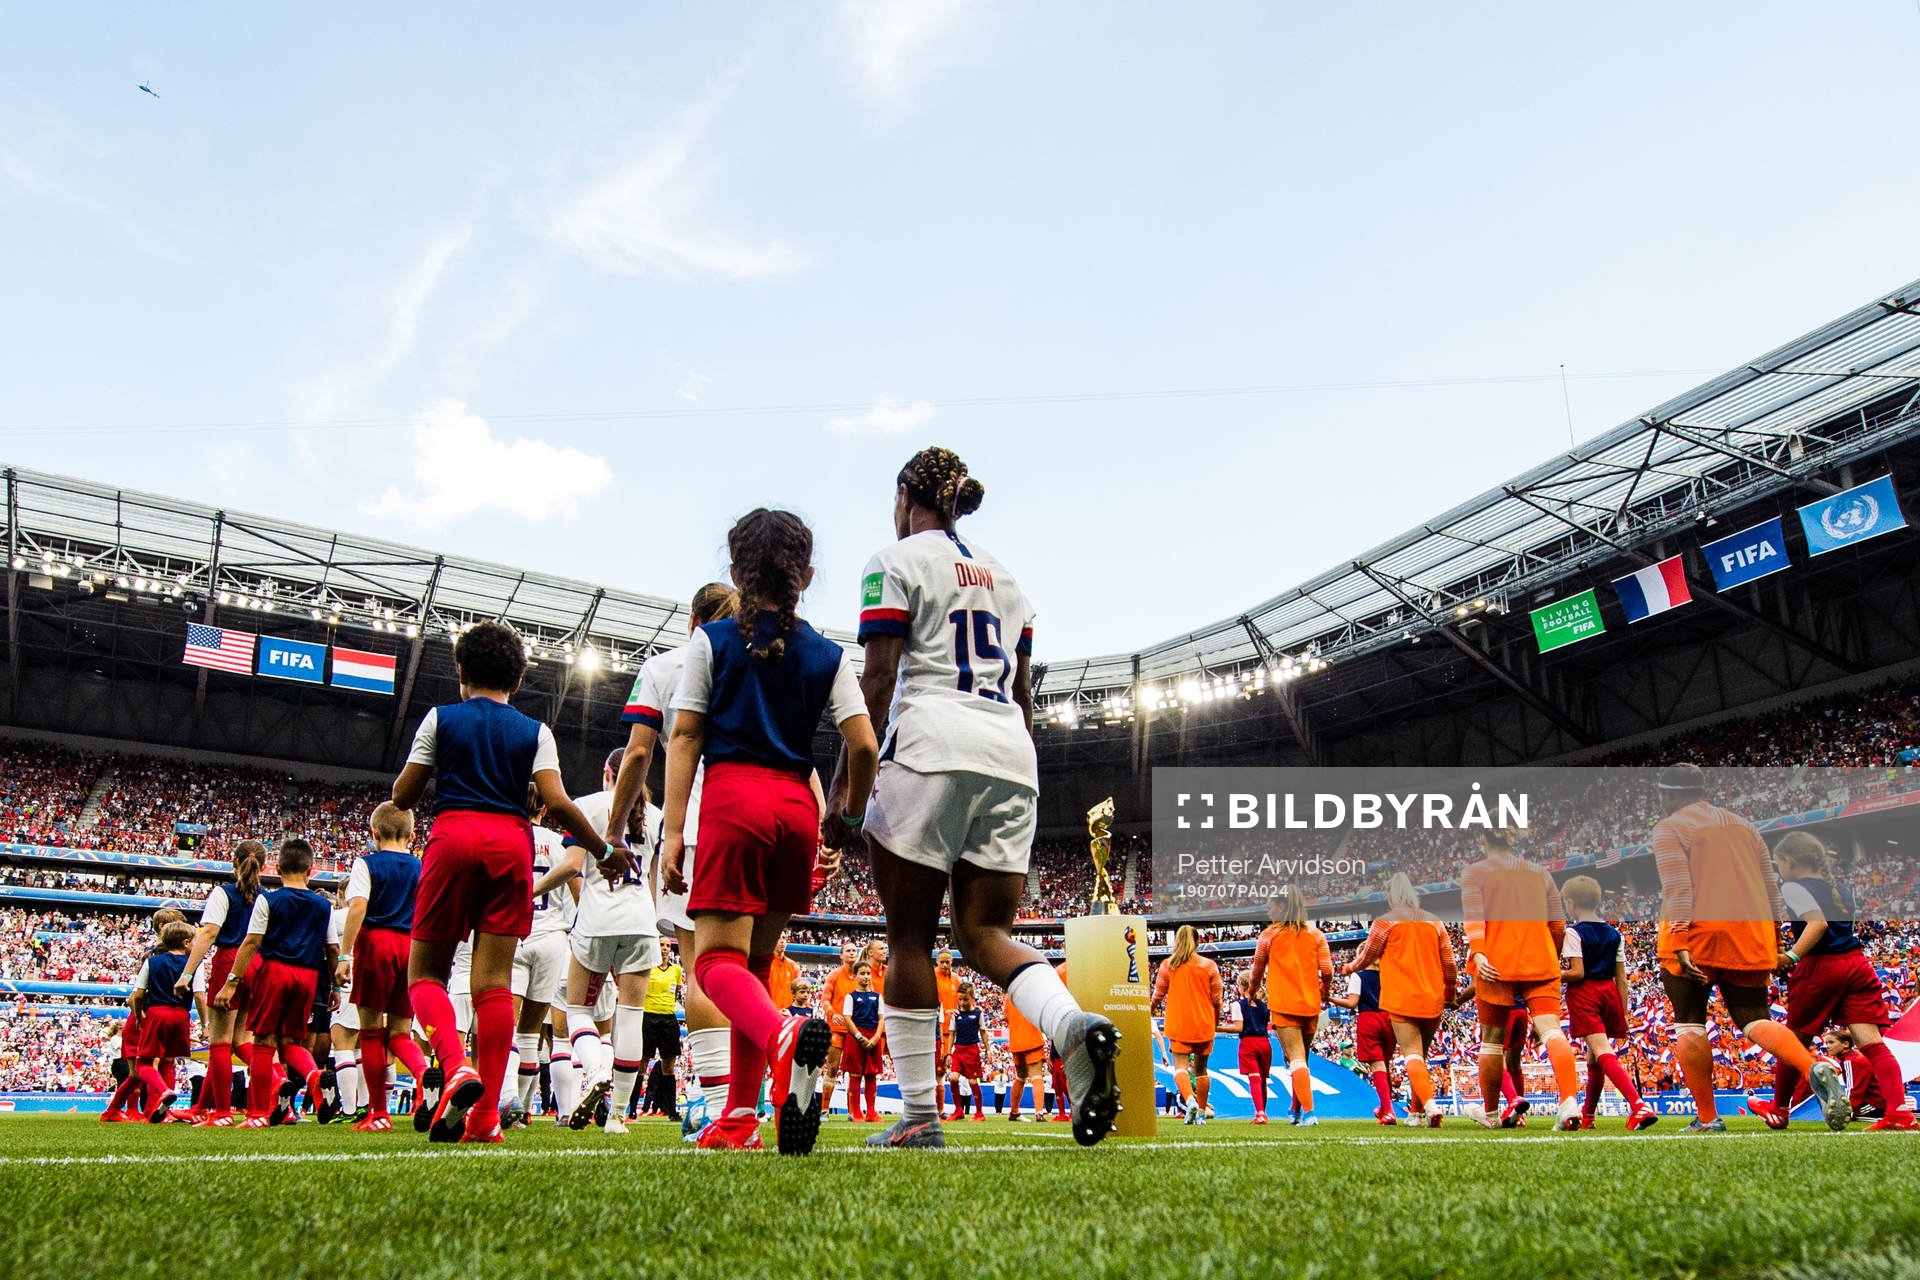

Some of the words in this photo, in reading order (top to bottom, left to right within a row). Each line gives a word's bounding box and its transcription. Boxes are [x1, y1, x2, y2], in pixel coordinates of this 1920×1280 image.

[1720, 540, 1778, 573] FIFA
[954, 562, 995, 592] DUNN
[1541, 600, 1590, 623] LIVING
[1543, 607, 1592, 630] FOOTBALL
[1573, 621, 1596, 635] FIFA
[269, 649, 315, 670] FIFA
[949, 609, 1011, 704] 19
